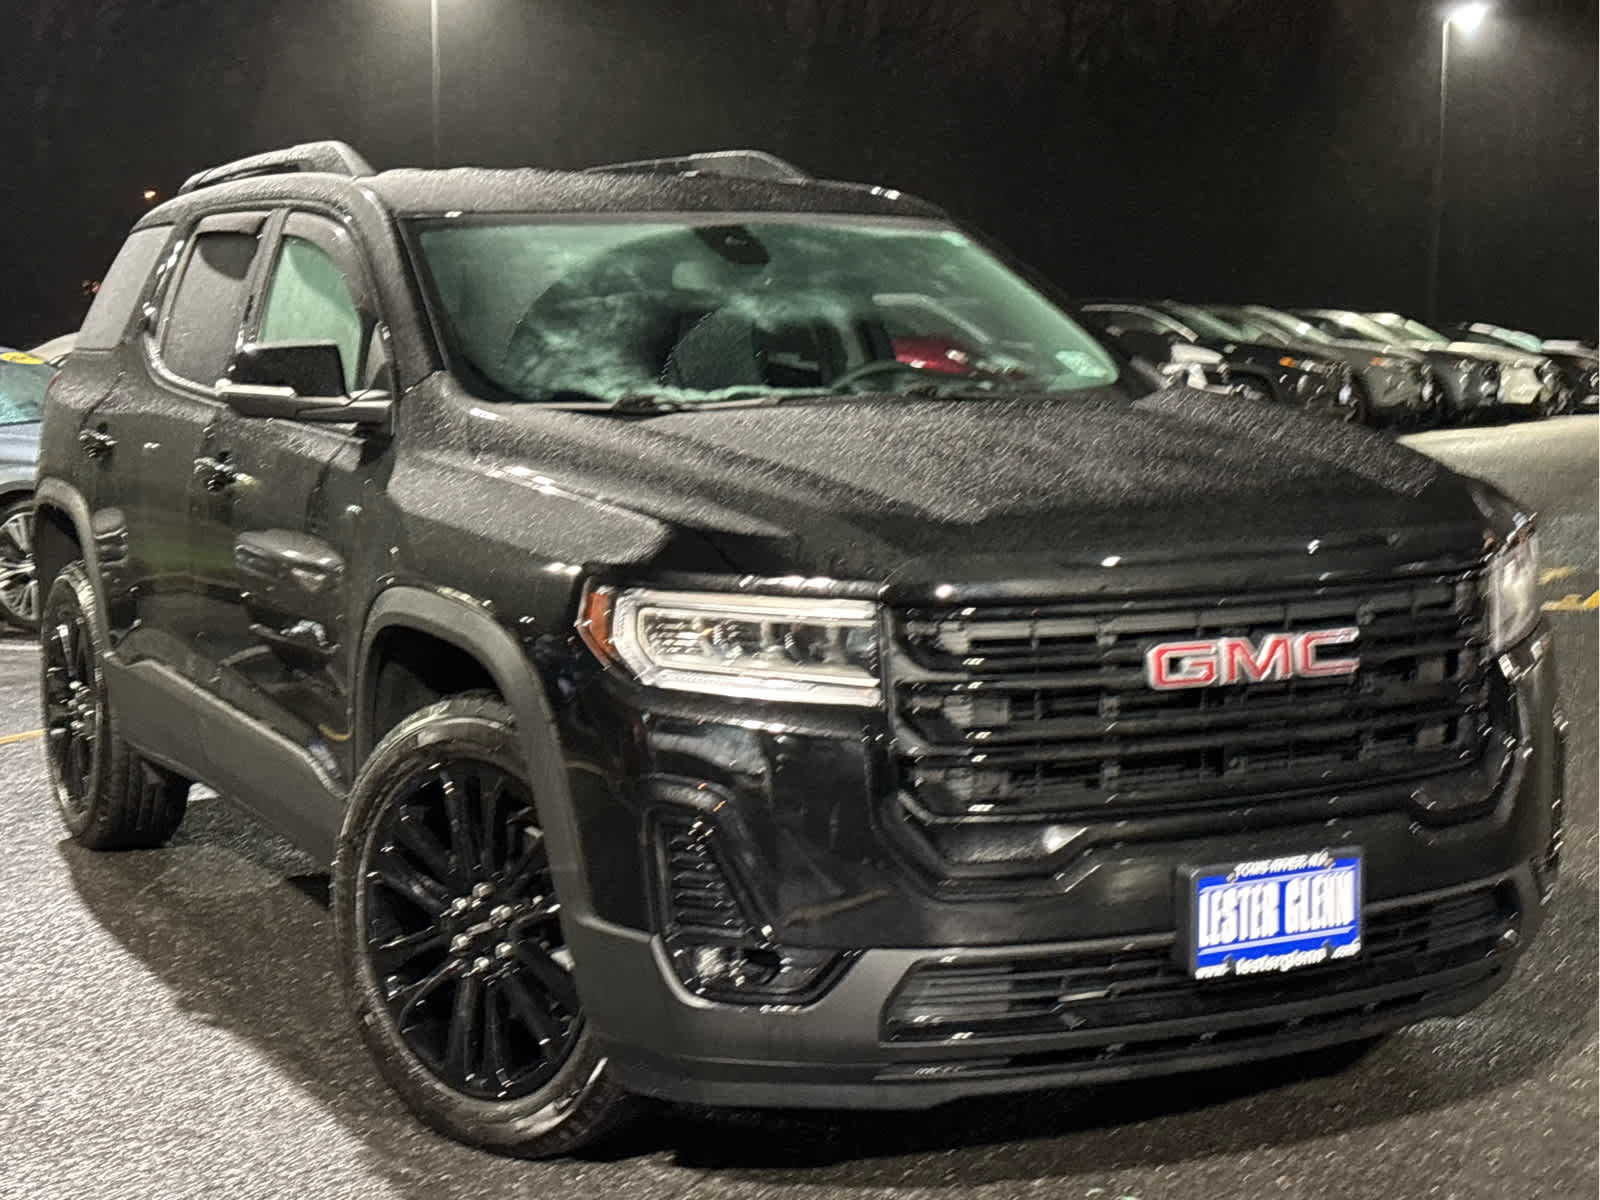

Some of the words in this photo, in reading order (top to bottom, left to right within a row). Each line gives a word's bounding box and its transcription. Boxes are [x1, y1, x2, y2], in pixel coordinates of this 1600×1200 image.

[1147, 627, 1360, 690] GMC
[1199, 882, 1280, 948] LESTER
[1284, 870, 1354, 934] GLENN
